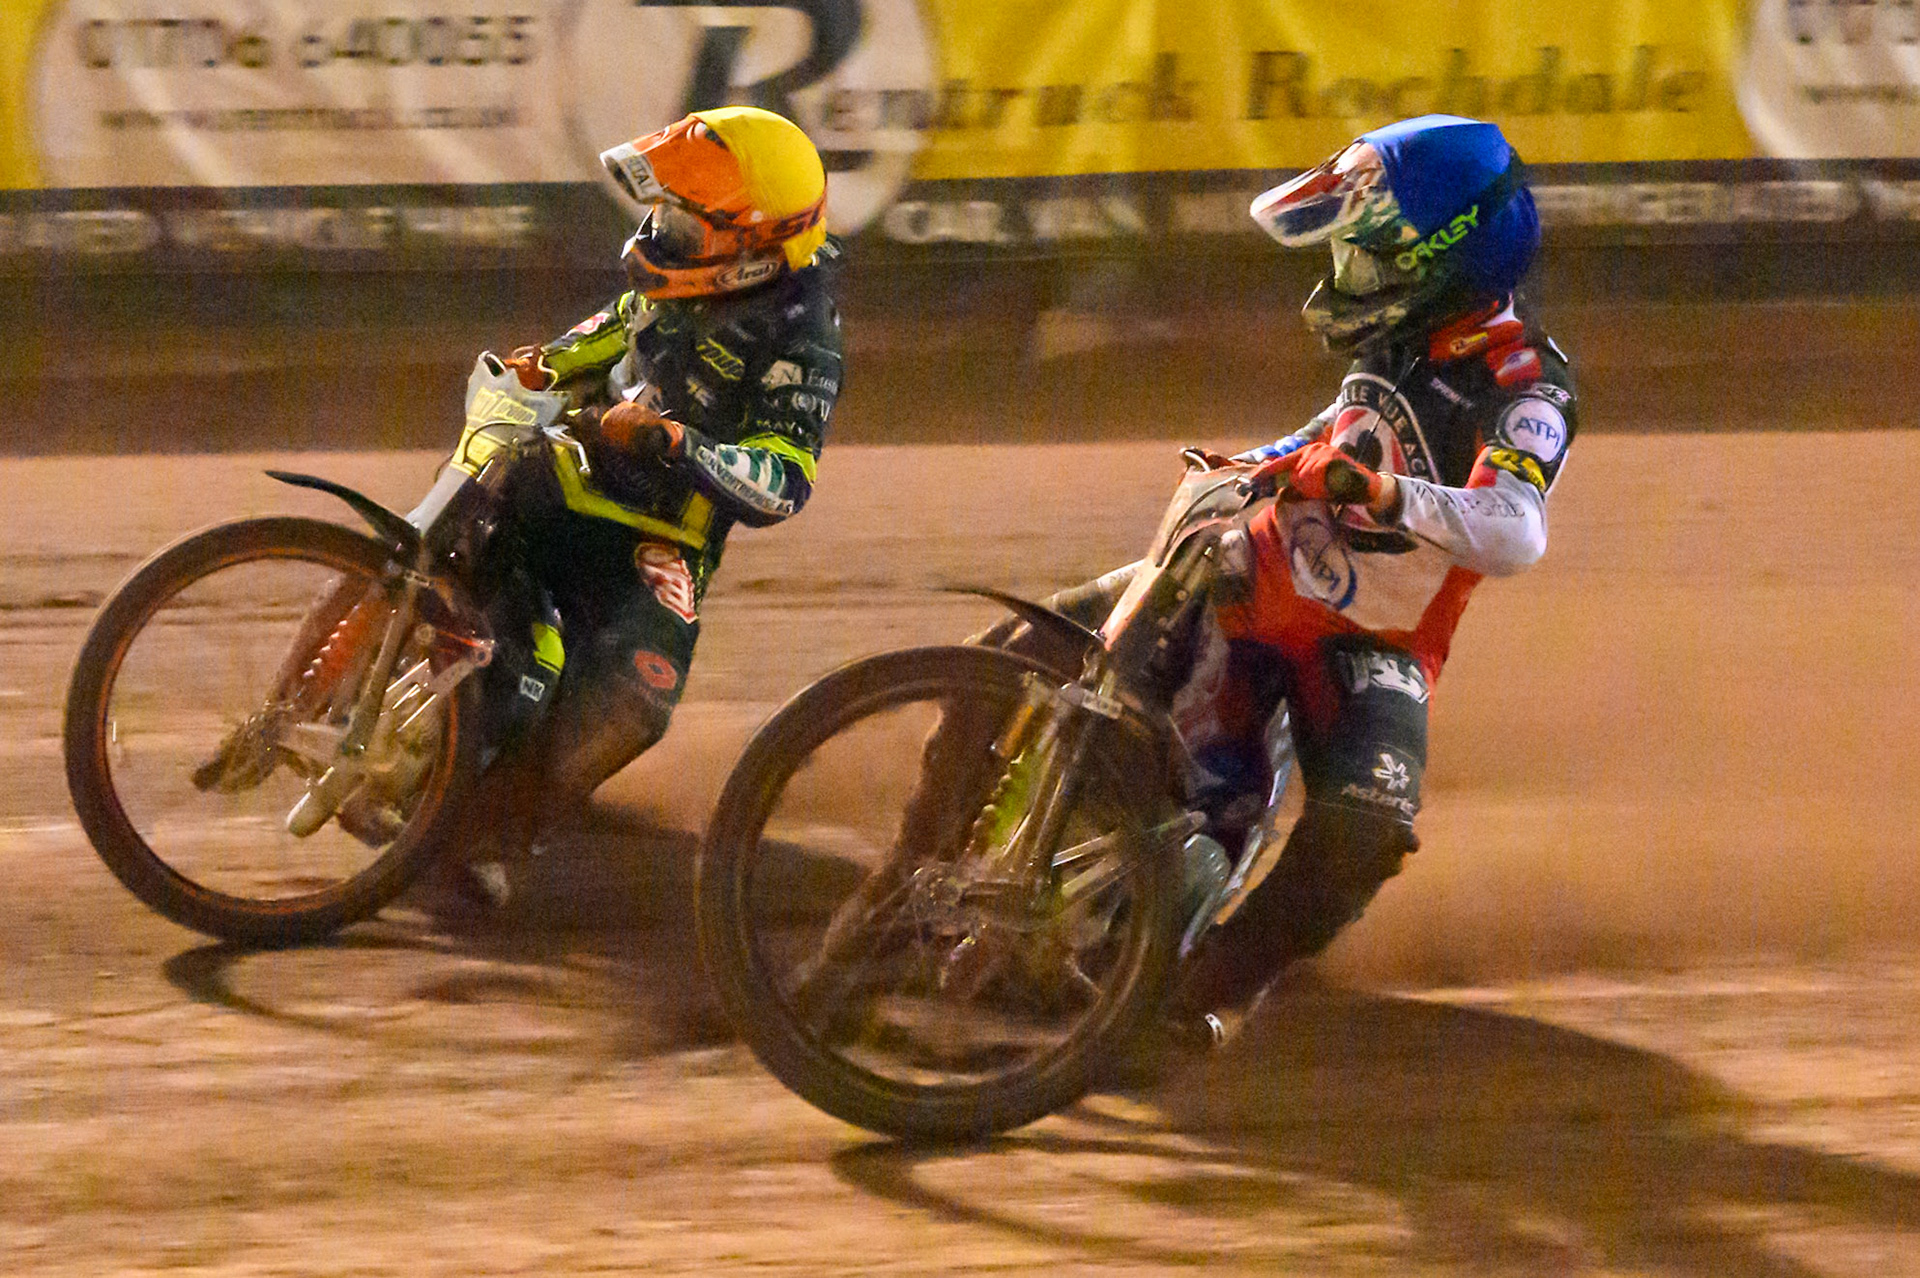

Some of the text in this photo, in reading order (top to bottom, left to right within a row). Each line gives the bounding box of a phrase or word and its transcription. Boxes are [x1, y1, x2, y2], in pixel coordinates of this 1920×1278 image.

[1243, 47, 1705, 119] Rochdale
[1396, 204, 1478, 270] OAKLEY
[1342, 385, 1369, 404] LLE
[1513, 416, 1561, 448] ATPI
